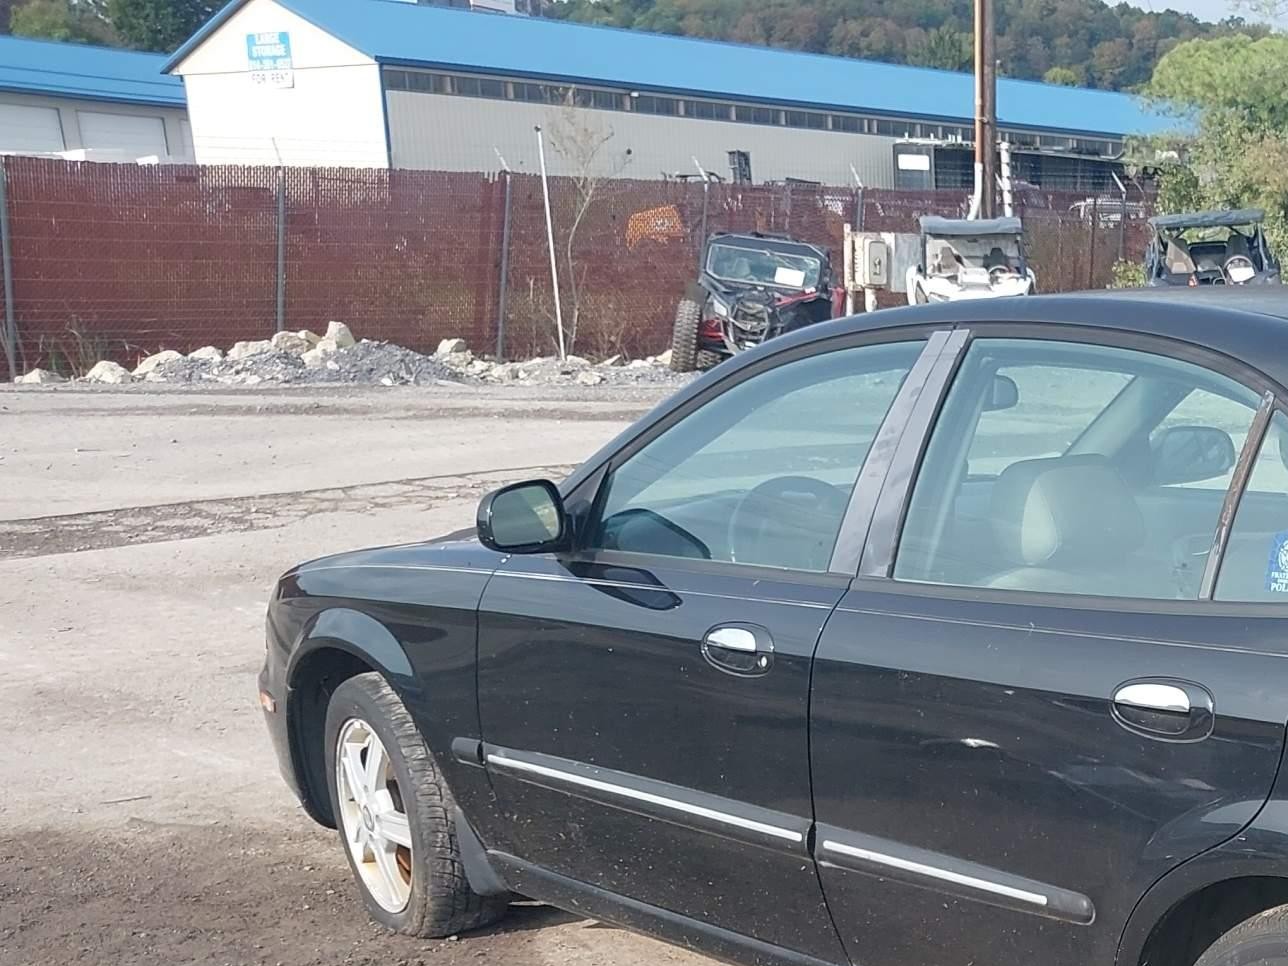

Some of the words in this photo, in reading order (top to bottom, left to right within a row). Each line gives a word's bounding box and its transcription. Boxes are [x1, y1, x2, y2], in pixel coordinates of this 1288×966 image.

[251, 44, 287, 58] STORAGE
[251, 72, 266, 84] FOR
[271, 71, 289, 83] RENT
